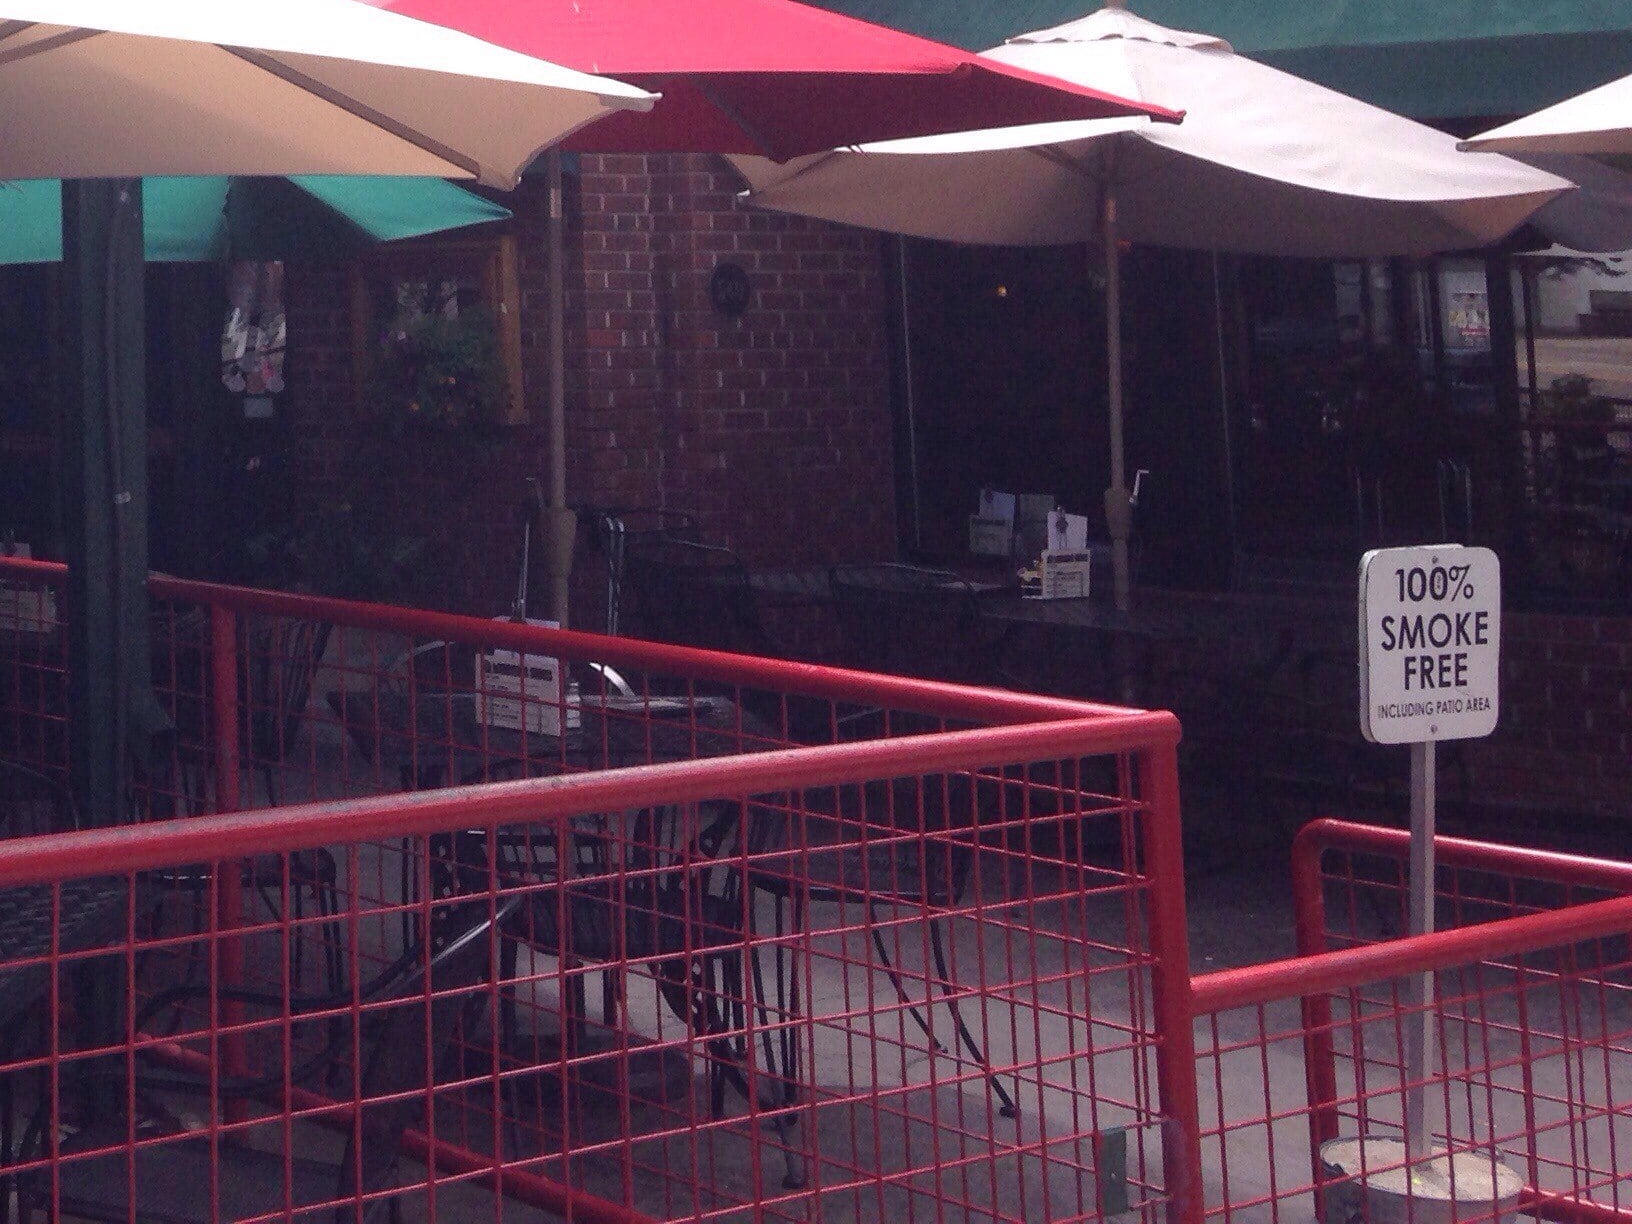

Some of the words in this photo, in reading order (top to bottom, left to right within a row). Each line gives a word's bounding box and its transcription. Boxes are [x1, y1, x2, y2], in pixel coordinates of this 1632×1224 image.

[1395, 564, 1474, 603] 100%
[1380, 611, 1489, 651] SMOKE
[1403, 652, 1468, 691] FREE
[1377, 701, 1434, 719] INCLUDING
[1436, 698, 1463, 715] PATIO
[1465, 697, 1491, 713] AREA
